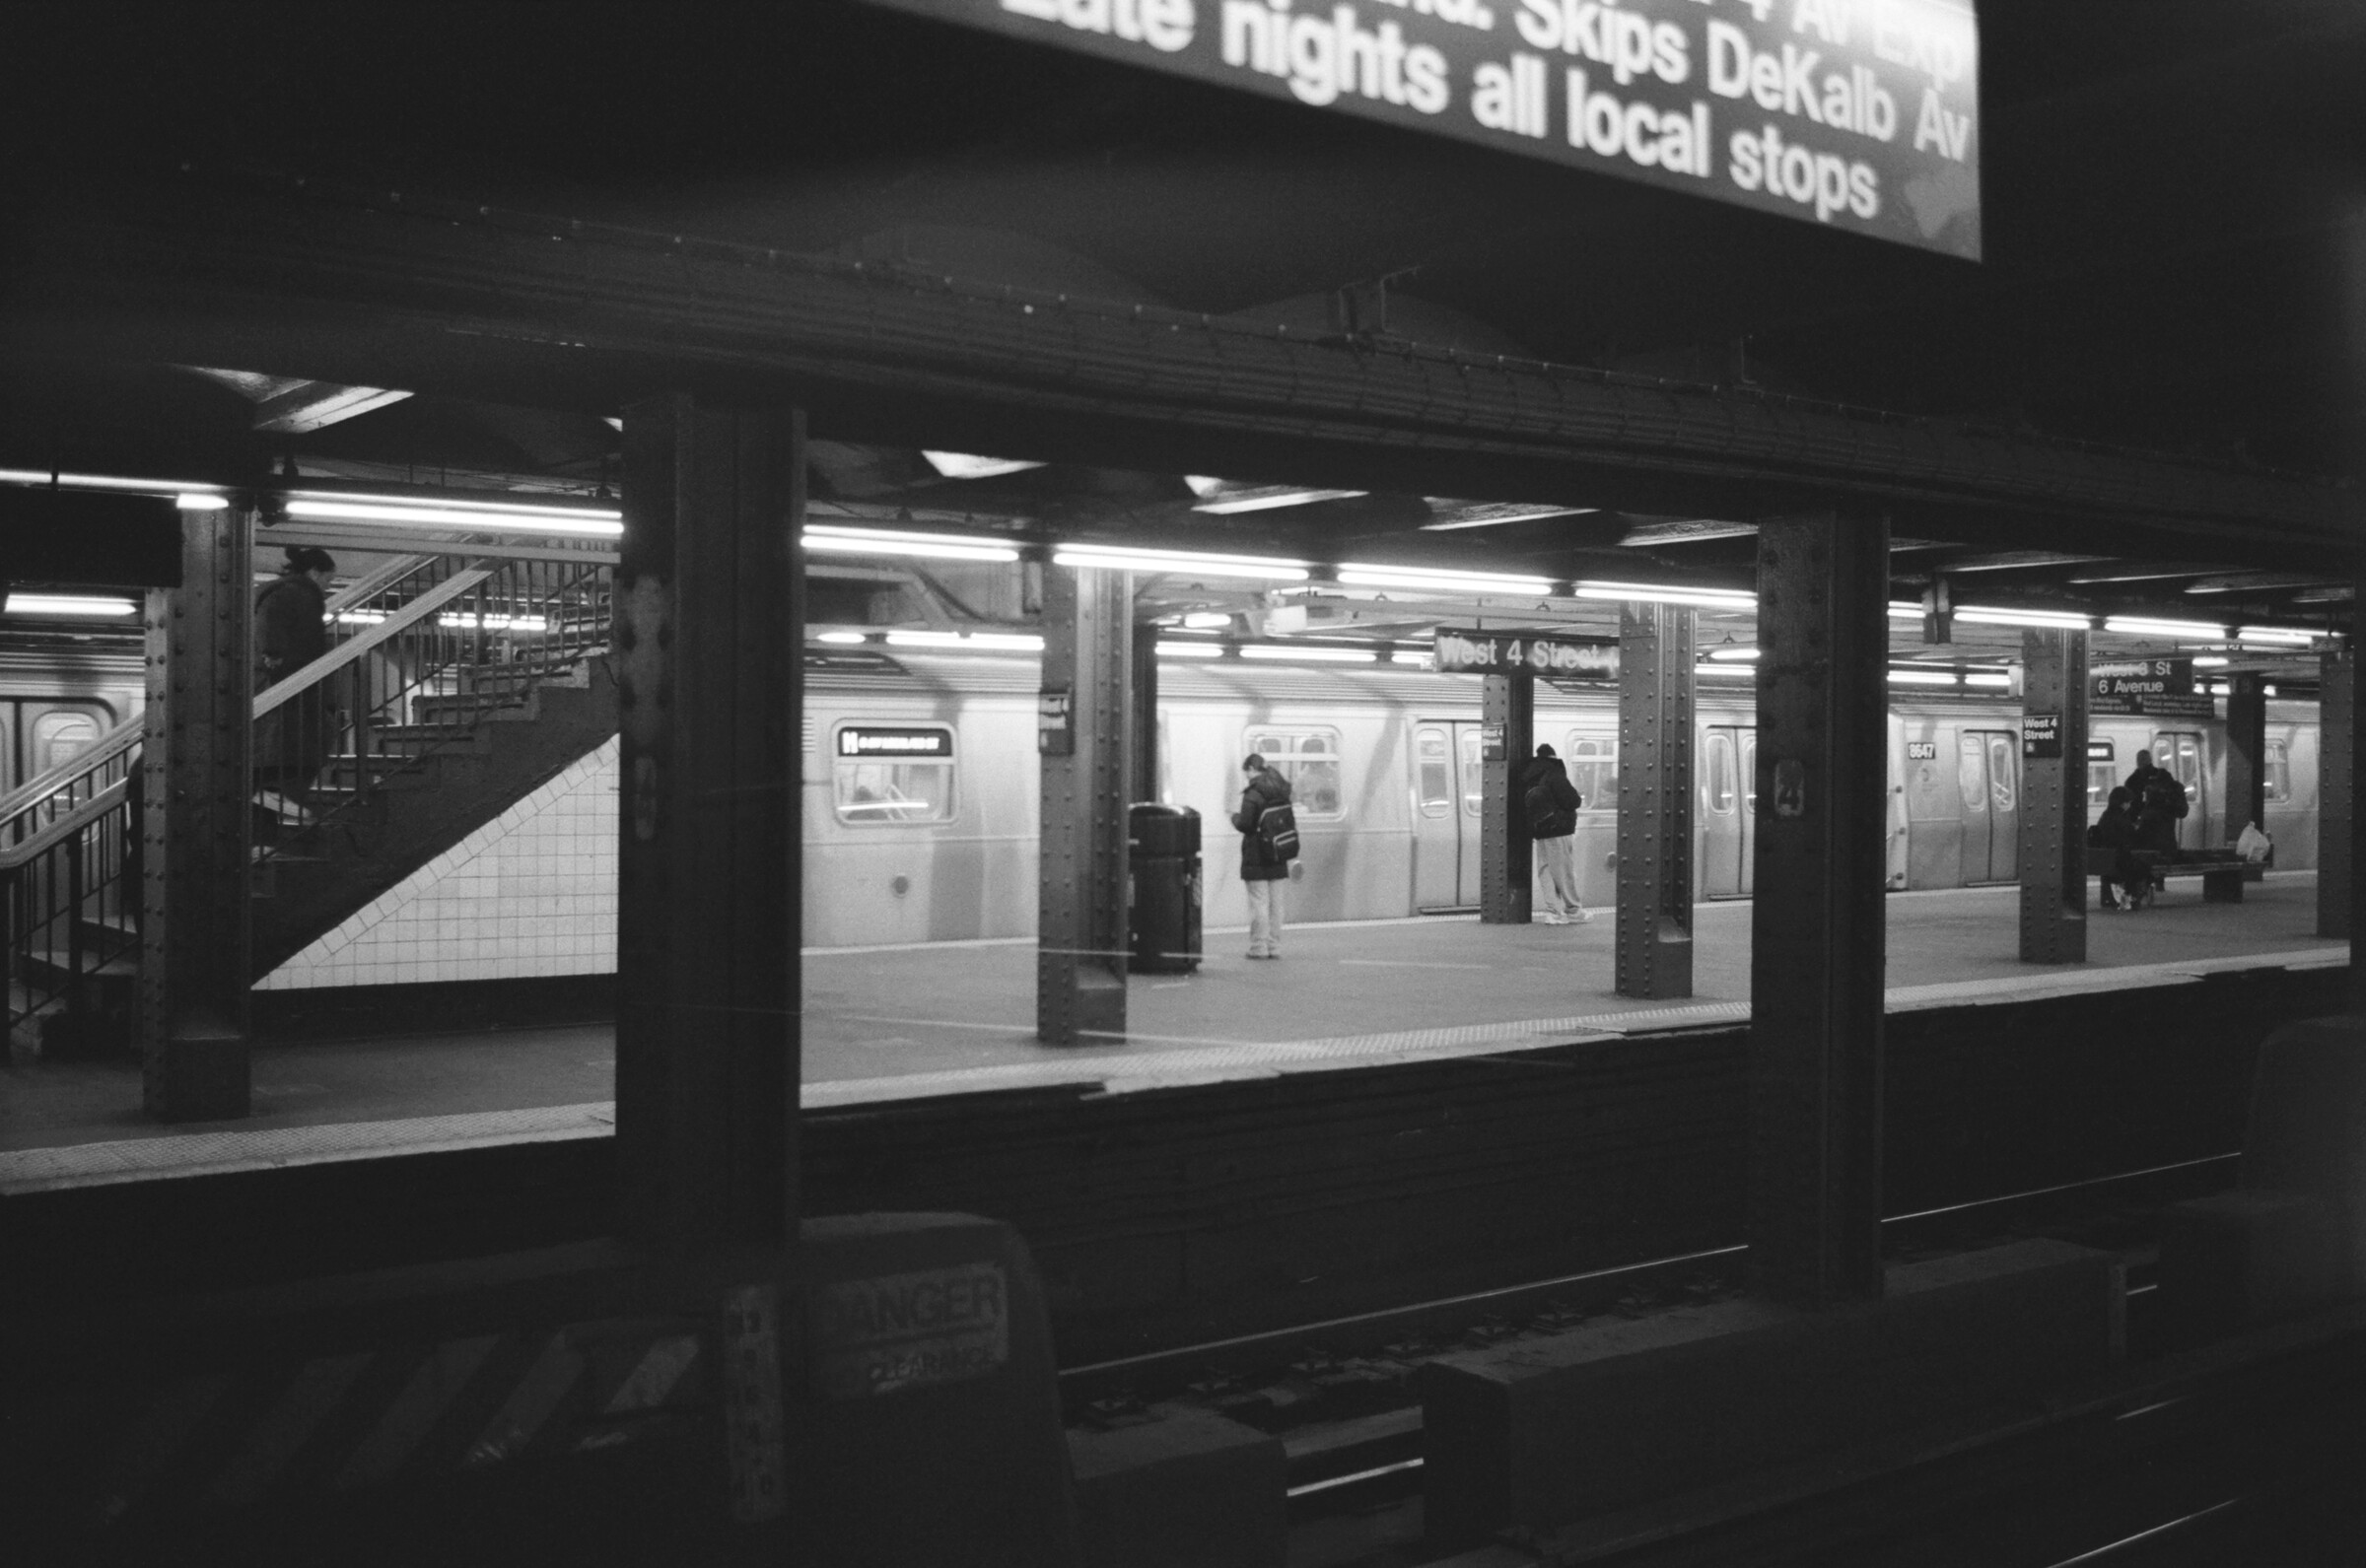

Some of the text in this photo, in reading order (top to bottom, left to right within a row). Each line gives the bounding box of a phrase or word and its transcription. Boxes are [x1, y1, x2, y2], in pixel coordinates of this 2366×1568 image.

[1515, 0, 1970, 162] Skips DeKalb Av
[1000, 0, 1879, 222] te nights all local stops
[1440, 637, 1600, 669] West 4 Street
[2155, 660, 2172, 676] St
[2098, 679, 2165, 694] 6 Avenue
[2024, 717, 2057, 728] West 4
[2024, 729, 2054, 740] Street
[826, 1275, 1002, 1340] ANGER
